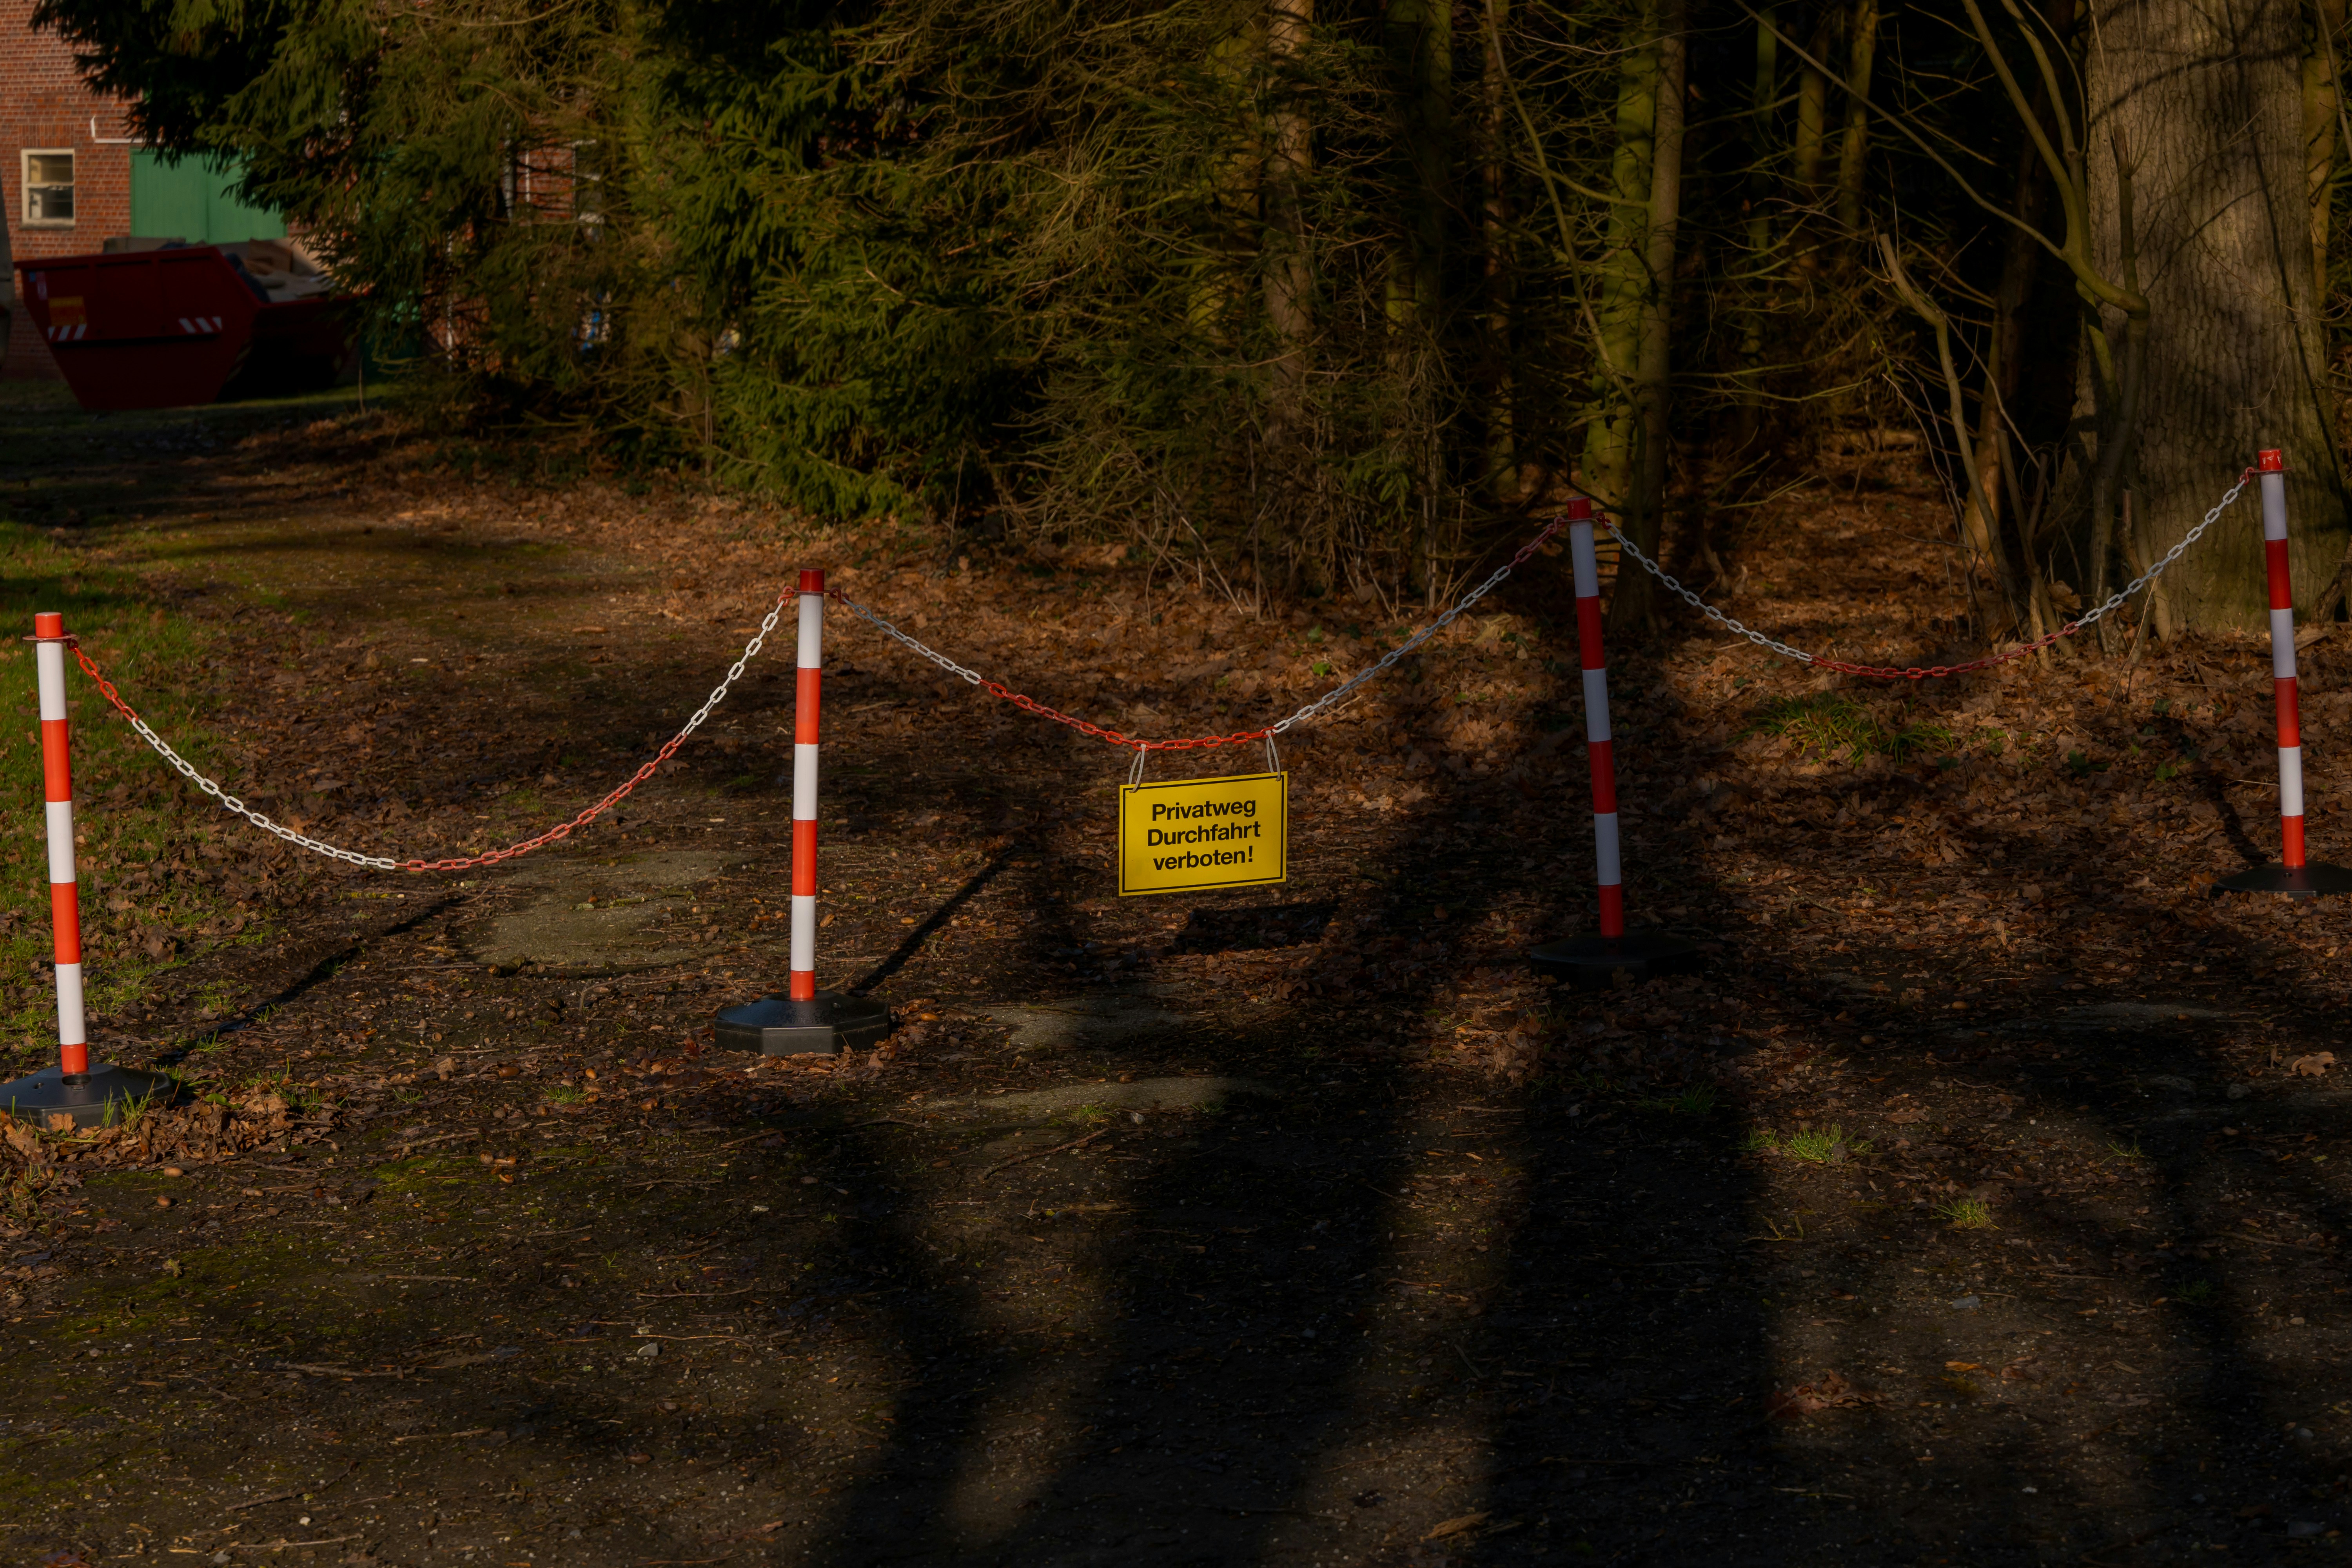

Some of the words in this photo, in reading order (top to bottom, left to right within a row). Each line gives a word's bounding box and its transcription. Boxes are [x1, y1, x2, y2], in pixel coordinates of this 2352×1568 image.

[1152, 800, 1256, 821] Privatweg
[1147, 821, 1261, 846] Durchfahrt
[1153, 845, 1253, 871] verboten!
